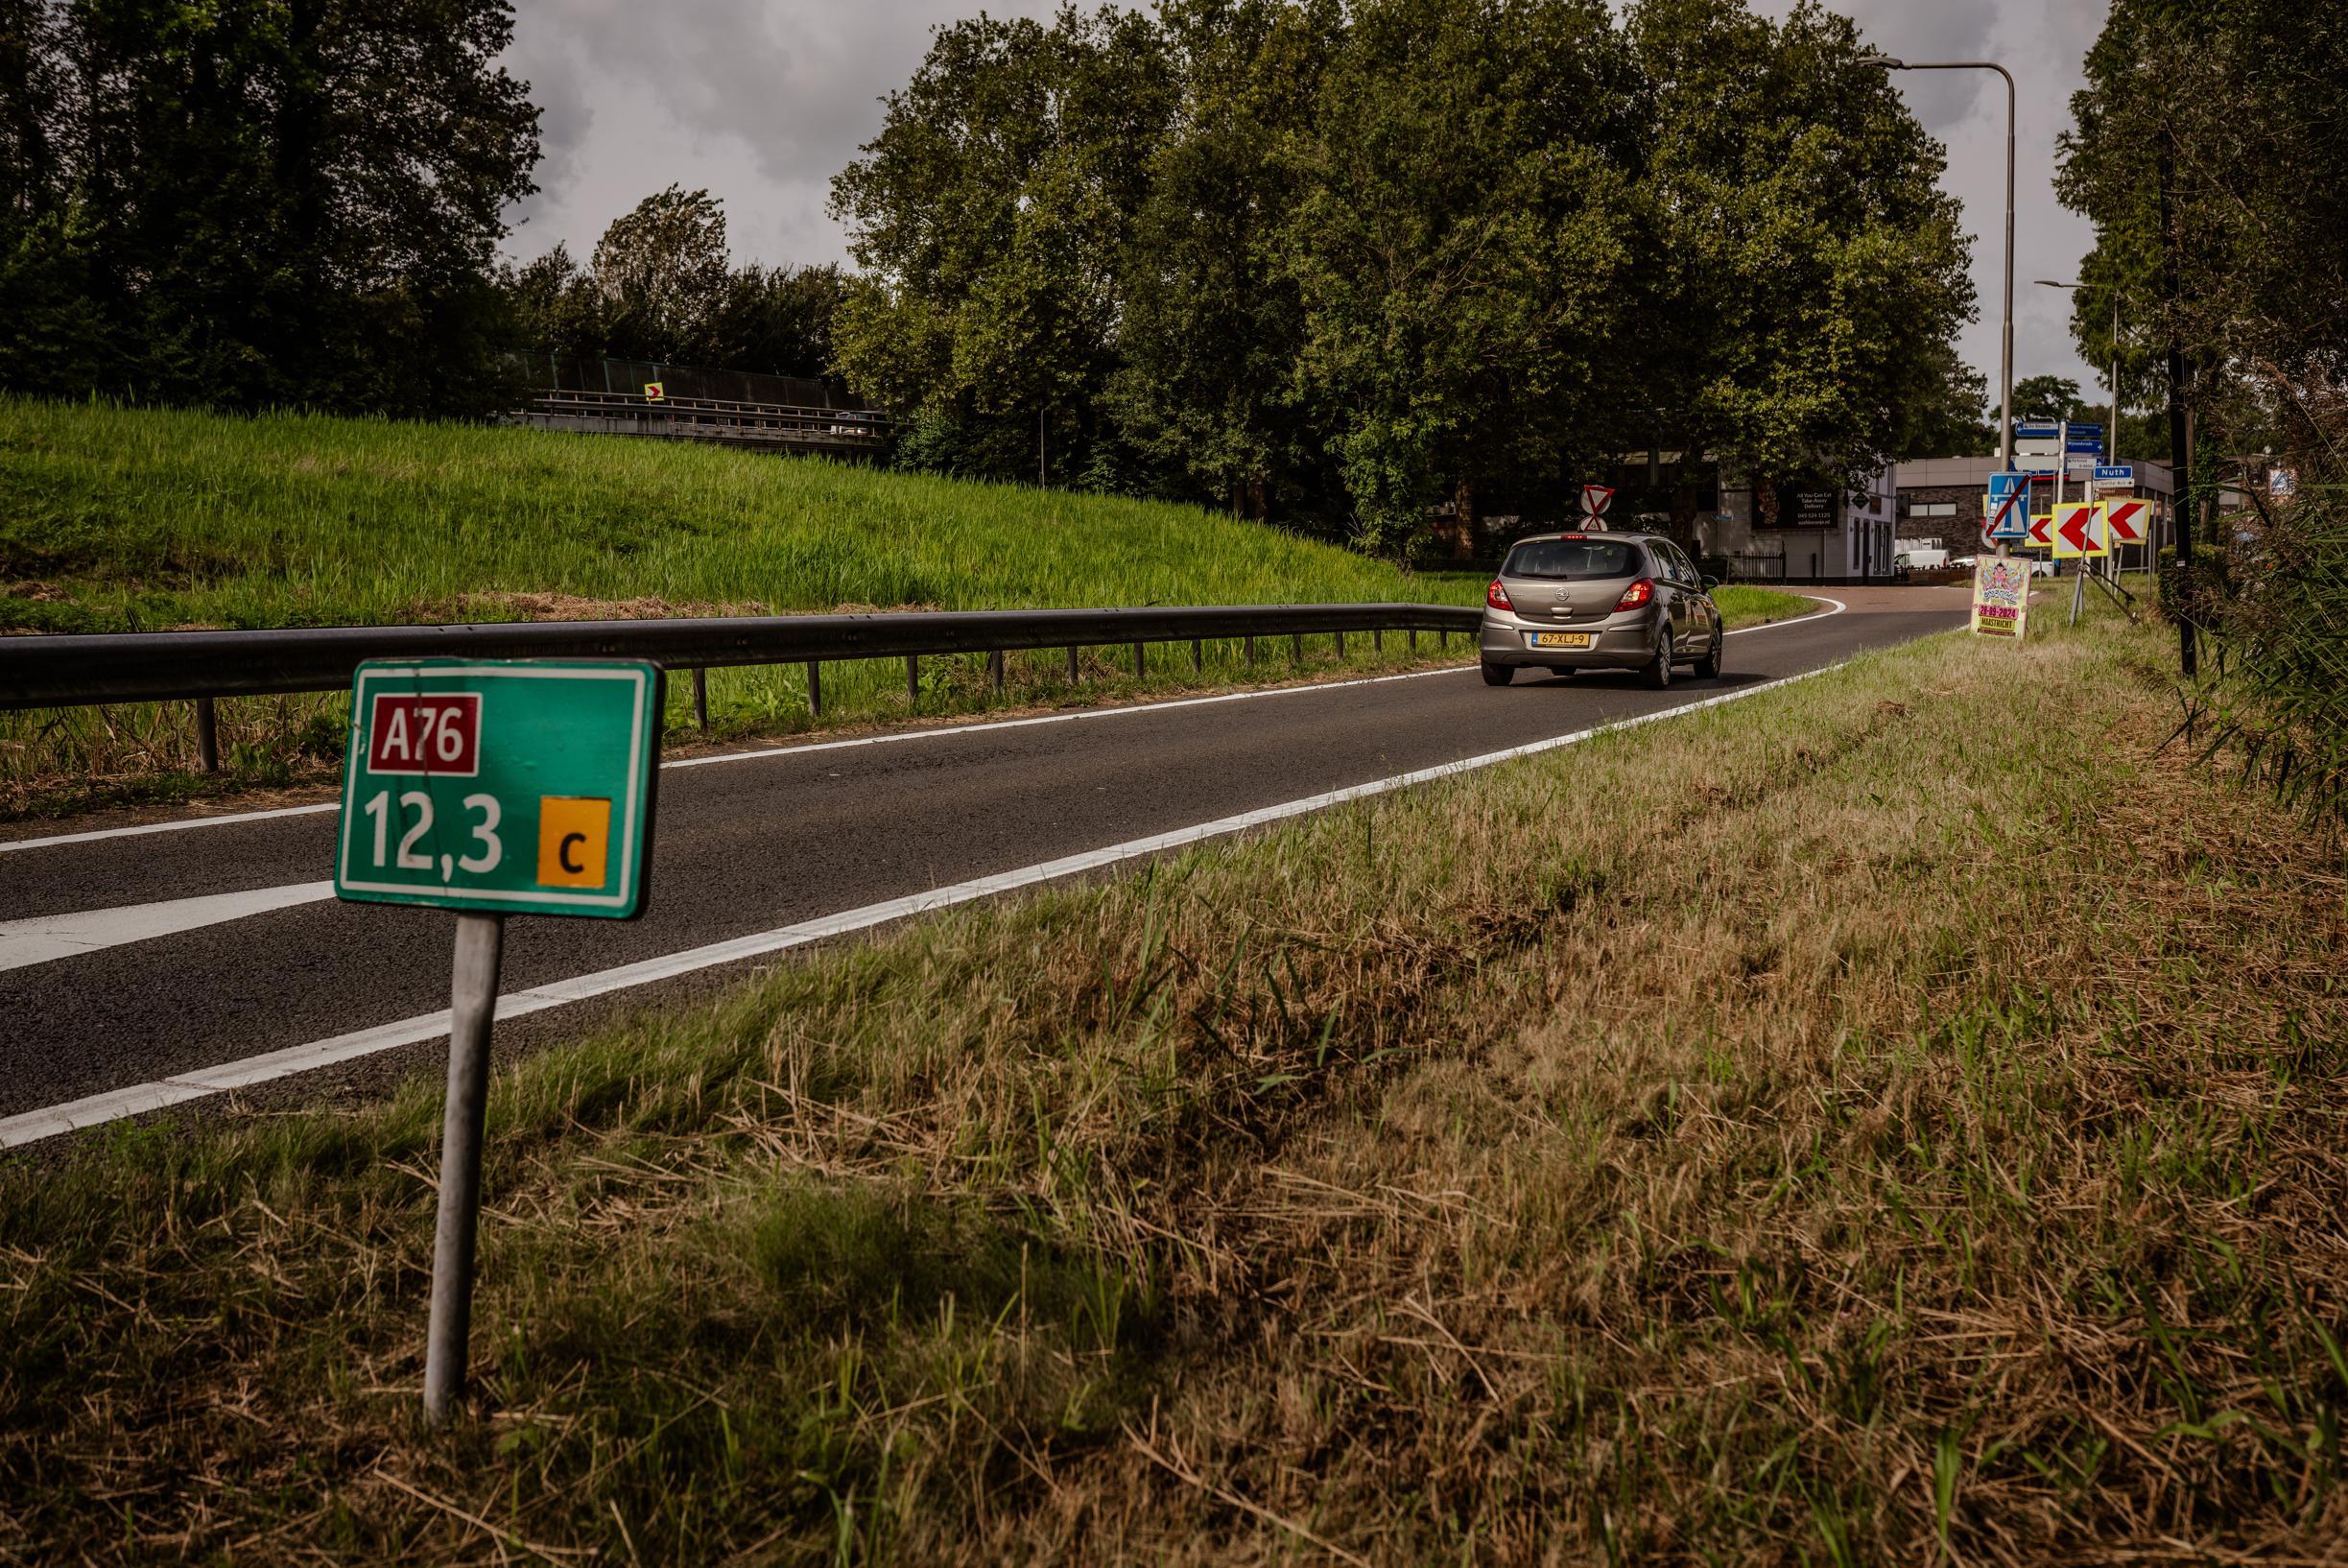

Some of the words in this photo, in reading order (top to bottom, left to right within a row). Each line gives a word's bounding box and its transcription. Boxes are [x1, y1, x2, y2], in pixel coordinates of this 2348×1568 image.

[1542, 634, 1585, 644] 67-XLJ-9
[1981, 617, 2012, 629] MAASTRICHT
[380, 706, 463, 762] A76
[364, 790, 503, 883] 12,3
